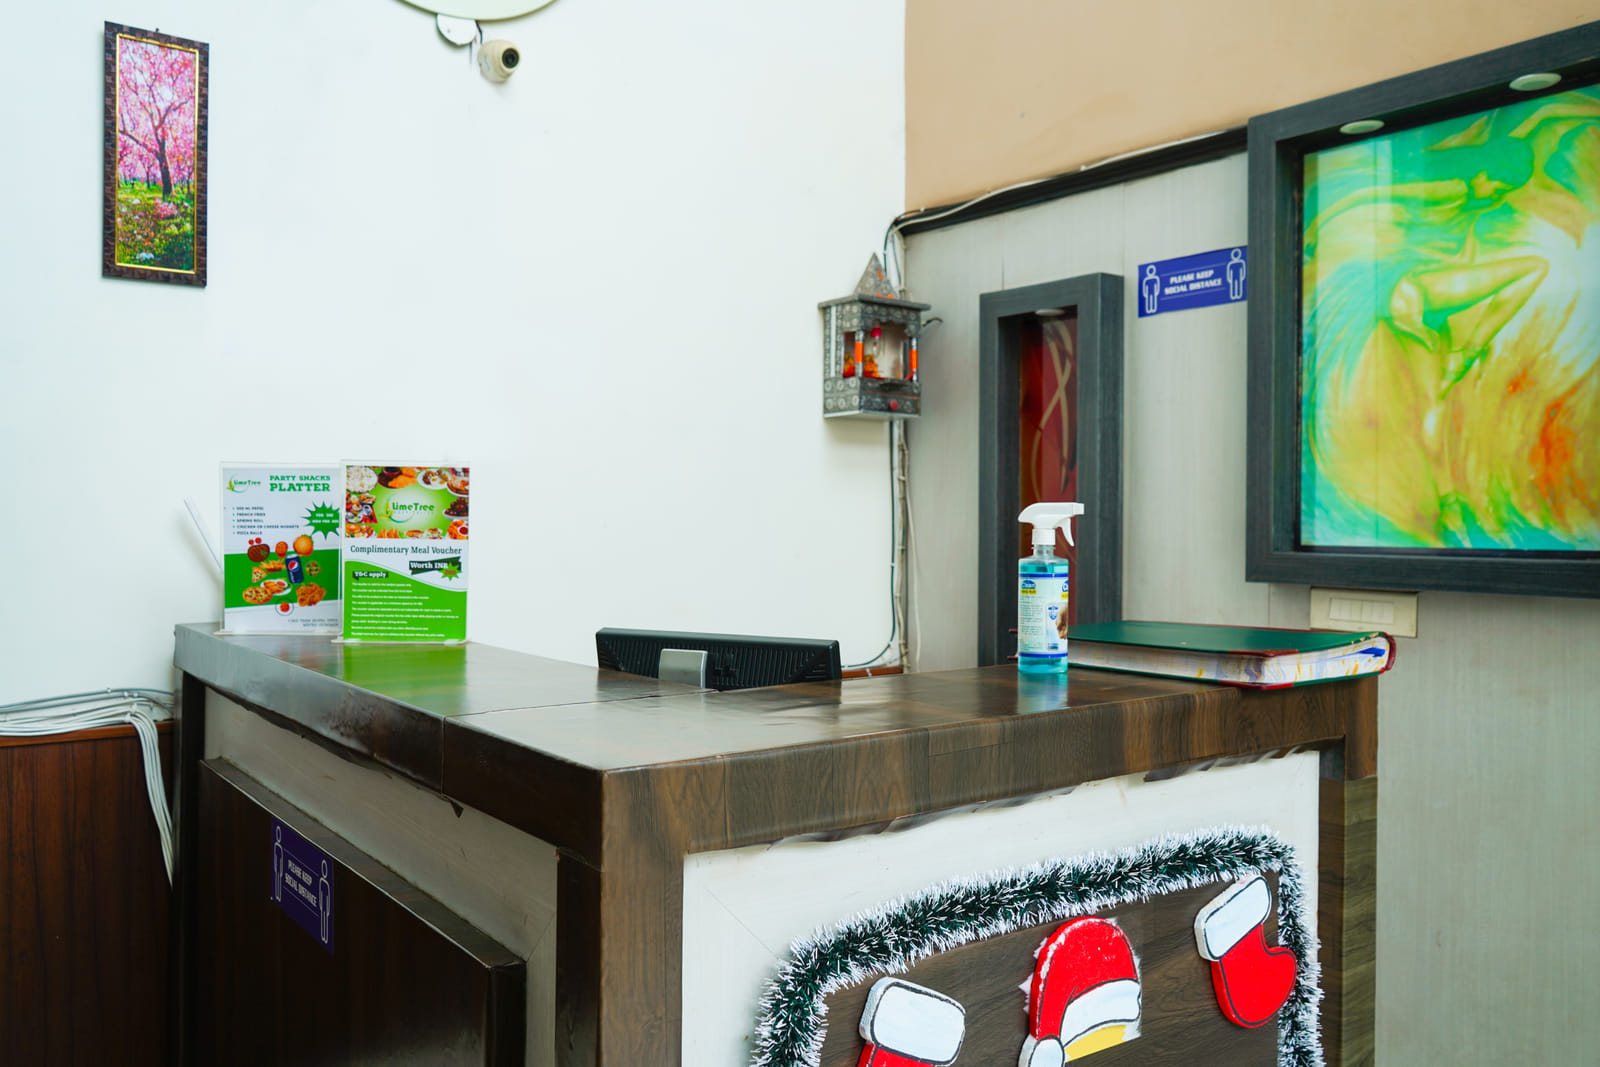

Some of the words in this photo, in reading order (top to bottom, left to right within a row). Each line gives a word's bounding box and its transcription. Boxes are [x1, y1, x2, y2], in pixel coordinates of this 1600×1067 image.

[1170, 273, 1194, 284] PLEASE
[1196, 269, 1214, 280] KEEP
[1164, 284, 1187, 295] SOCIAL
[1189, 278, 1222, 291] DISTANCE
[269, 482, 331, 492] PLATTER
[350, 545, 409, 555] Complimentary
[411, 546, 429, 554] Meal
[431, 546, 462, 554] Voucher
[369, 571, 387, 579] apply
[287, 859, 302, 879] PLEASE
[302, 870, 313, 886] KEEP
[285, 872, 298, 892] SOCIAL
[298, 882, 317, 907] DISTANCE
